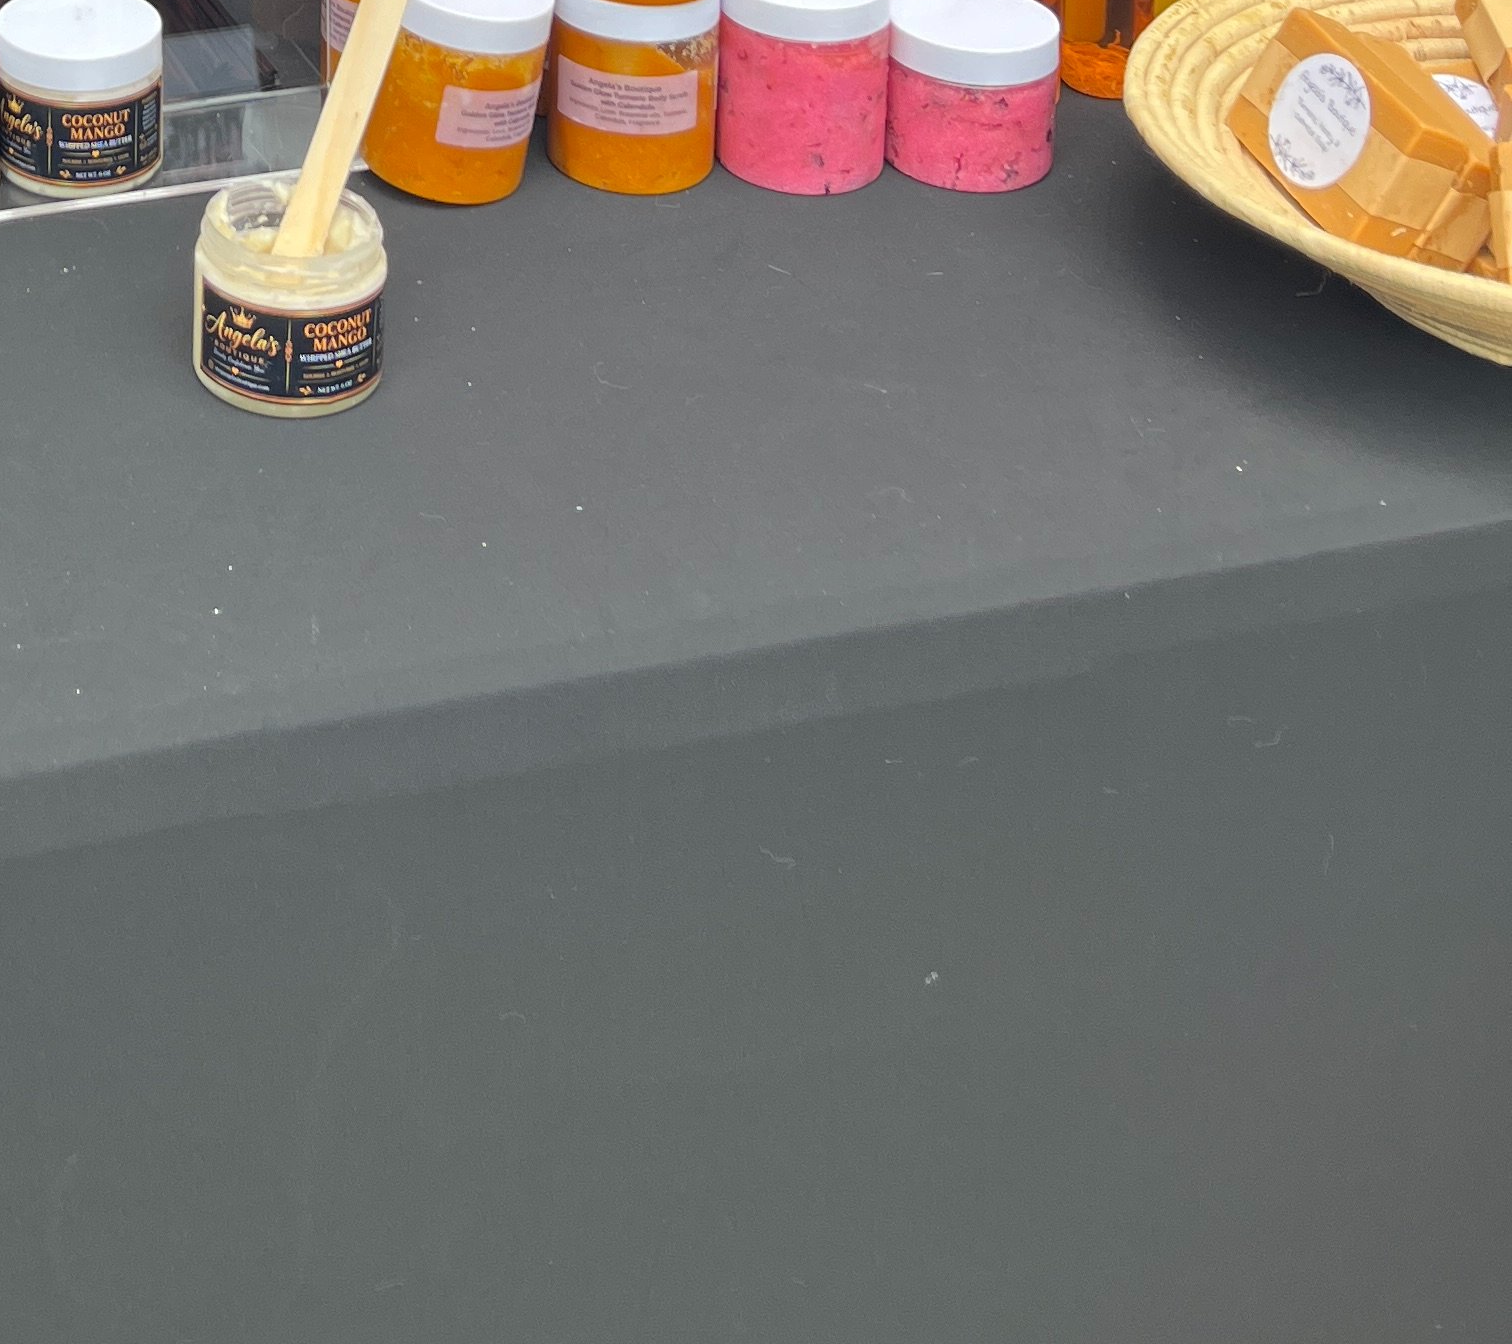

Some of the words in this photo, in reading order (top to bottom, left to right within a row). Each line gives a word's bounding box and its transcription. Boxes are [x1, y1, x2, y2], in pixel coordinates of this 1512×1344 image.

[61, 108, 131, 128] COCONUT
[70, 123, 125, 140] MANGO
[205, 311, 281, 358] Angela's
[303, 308, 373, 339] COCONUT
[313, 327, 367, 353] MANGO
